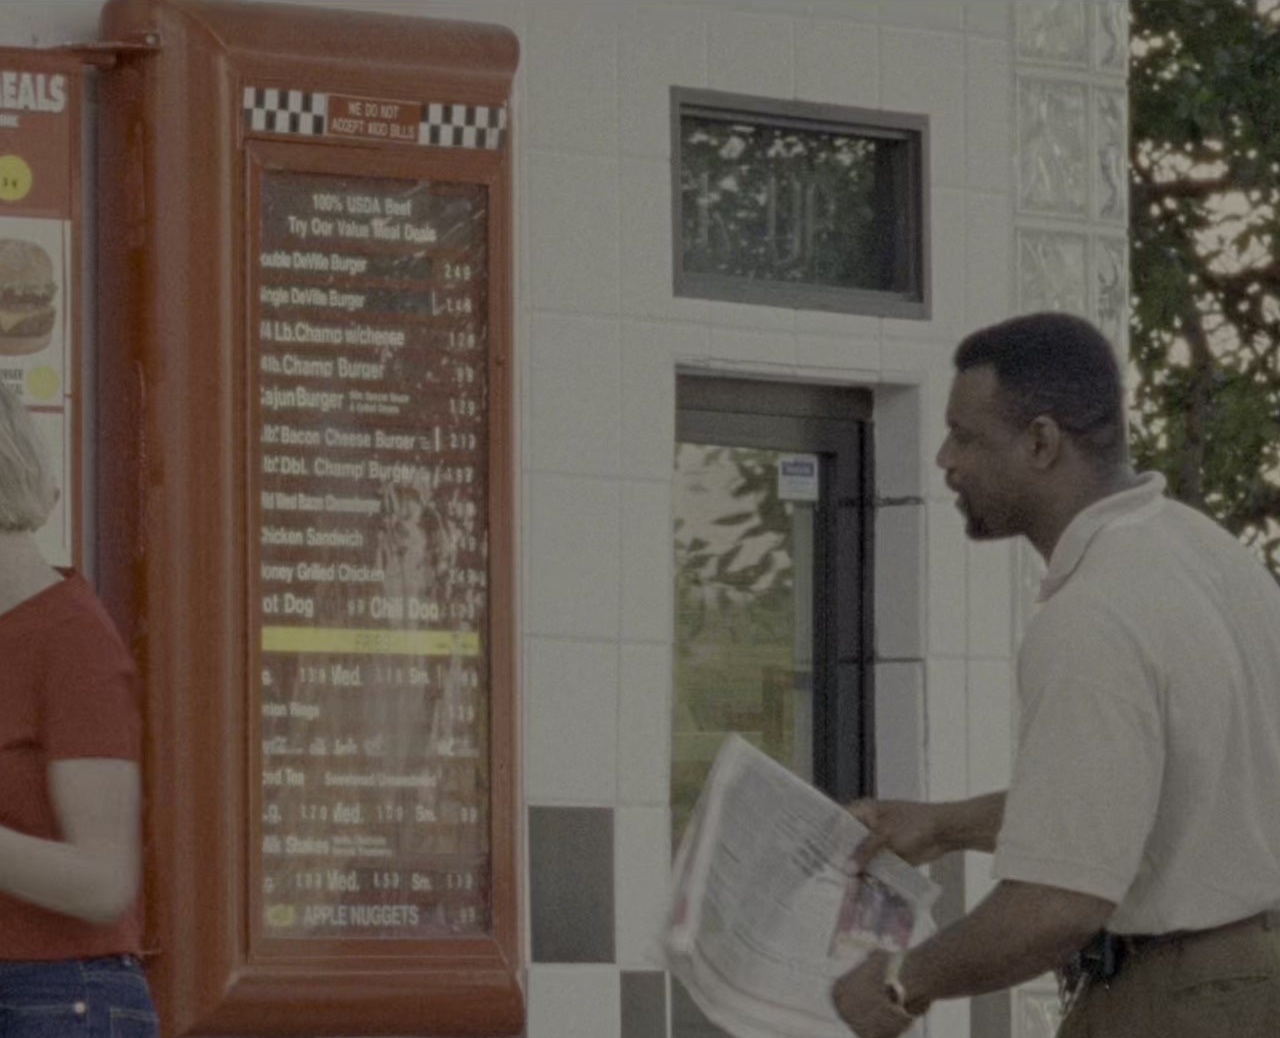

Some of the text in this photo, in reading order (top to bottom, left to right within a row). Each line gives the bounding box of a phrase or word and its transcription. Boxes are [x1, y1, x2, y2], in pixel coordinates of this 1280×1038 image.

[348, 102, 400, 120] WE DO NOT
[332, 119, 364, 134] ACCEPT
[390, 123, 415, 139] BILLS
[312, 193, 412, 217] 100% USDA Beef
[288, 215, 308, 239] Try
[311, 218, 333, 236] Our
[337, 219, 370, 238] Value
[260, 251, 291, 269] ouble
[330, 254, 368, 276] Burger
[260, 285, 290, 307] ingle
[328, 289, 366, 312] Burger
[337, 357, 386, 380] Burger
[261, 386, 295, 410] ajun
[296, 385, 344, 412] Burger
[280, 426, 320, 446] Bacon
[324, 427, 371, 448] Cheese
[375, 429, 416, 451] Burger
[369, 460, 417, 483] Burger
[306, 528, 364, 548] Sandwich
[296, 562, 335, 582] Grilled
[338, 564, 386, 583] Chicken
[262, 595, 279, 614] ot
[283, 593, 315, 619] Dog
[327, 870, 361, 892] Med.
[411, 873, 433, 892] Sm.
[303, 905, 347, 927] APPLE
[348, 905, 420, 927] NUGGETS
